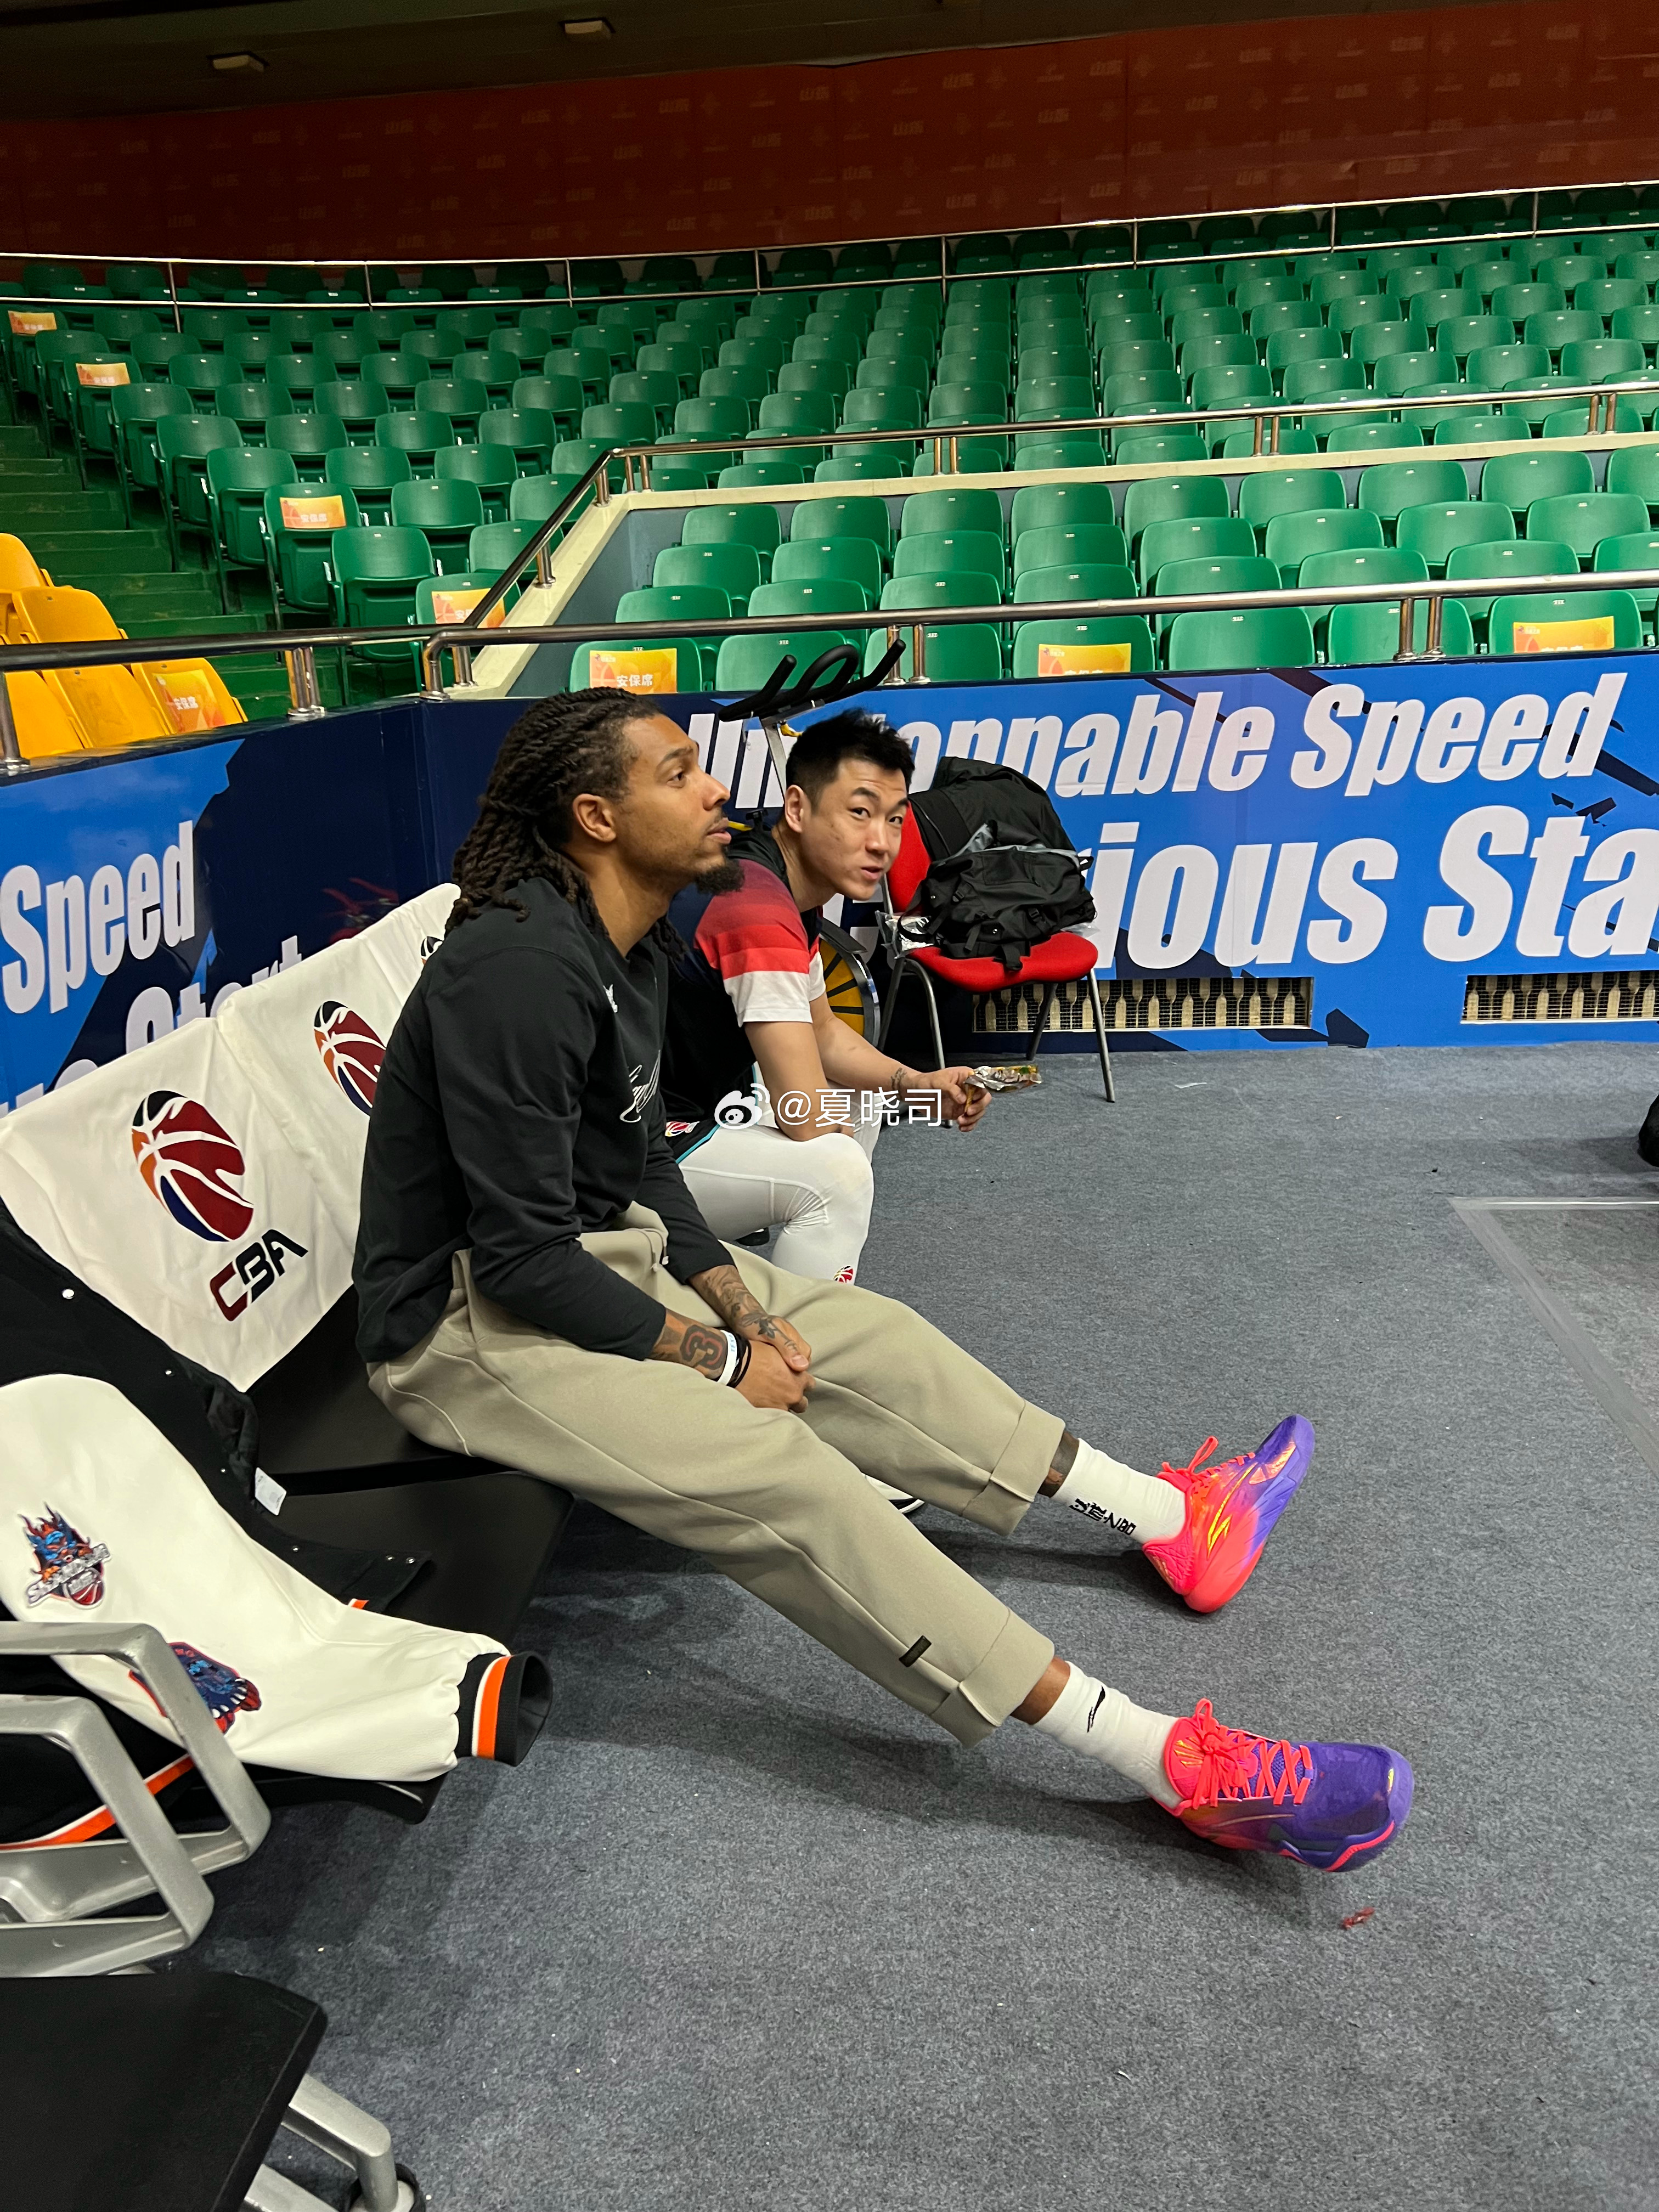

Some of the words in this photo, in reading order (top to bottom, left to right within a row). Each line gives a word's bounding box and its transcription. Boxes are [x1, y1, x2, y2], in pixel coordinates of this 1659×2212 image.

[616, 674, 653, 687] 安保席
[1290, 672, 1628, 797] Speed
[0, 820, 196, 1014] Speed
[210, 1229, 309, 1322] CBA
